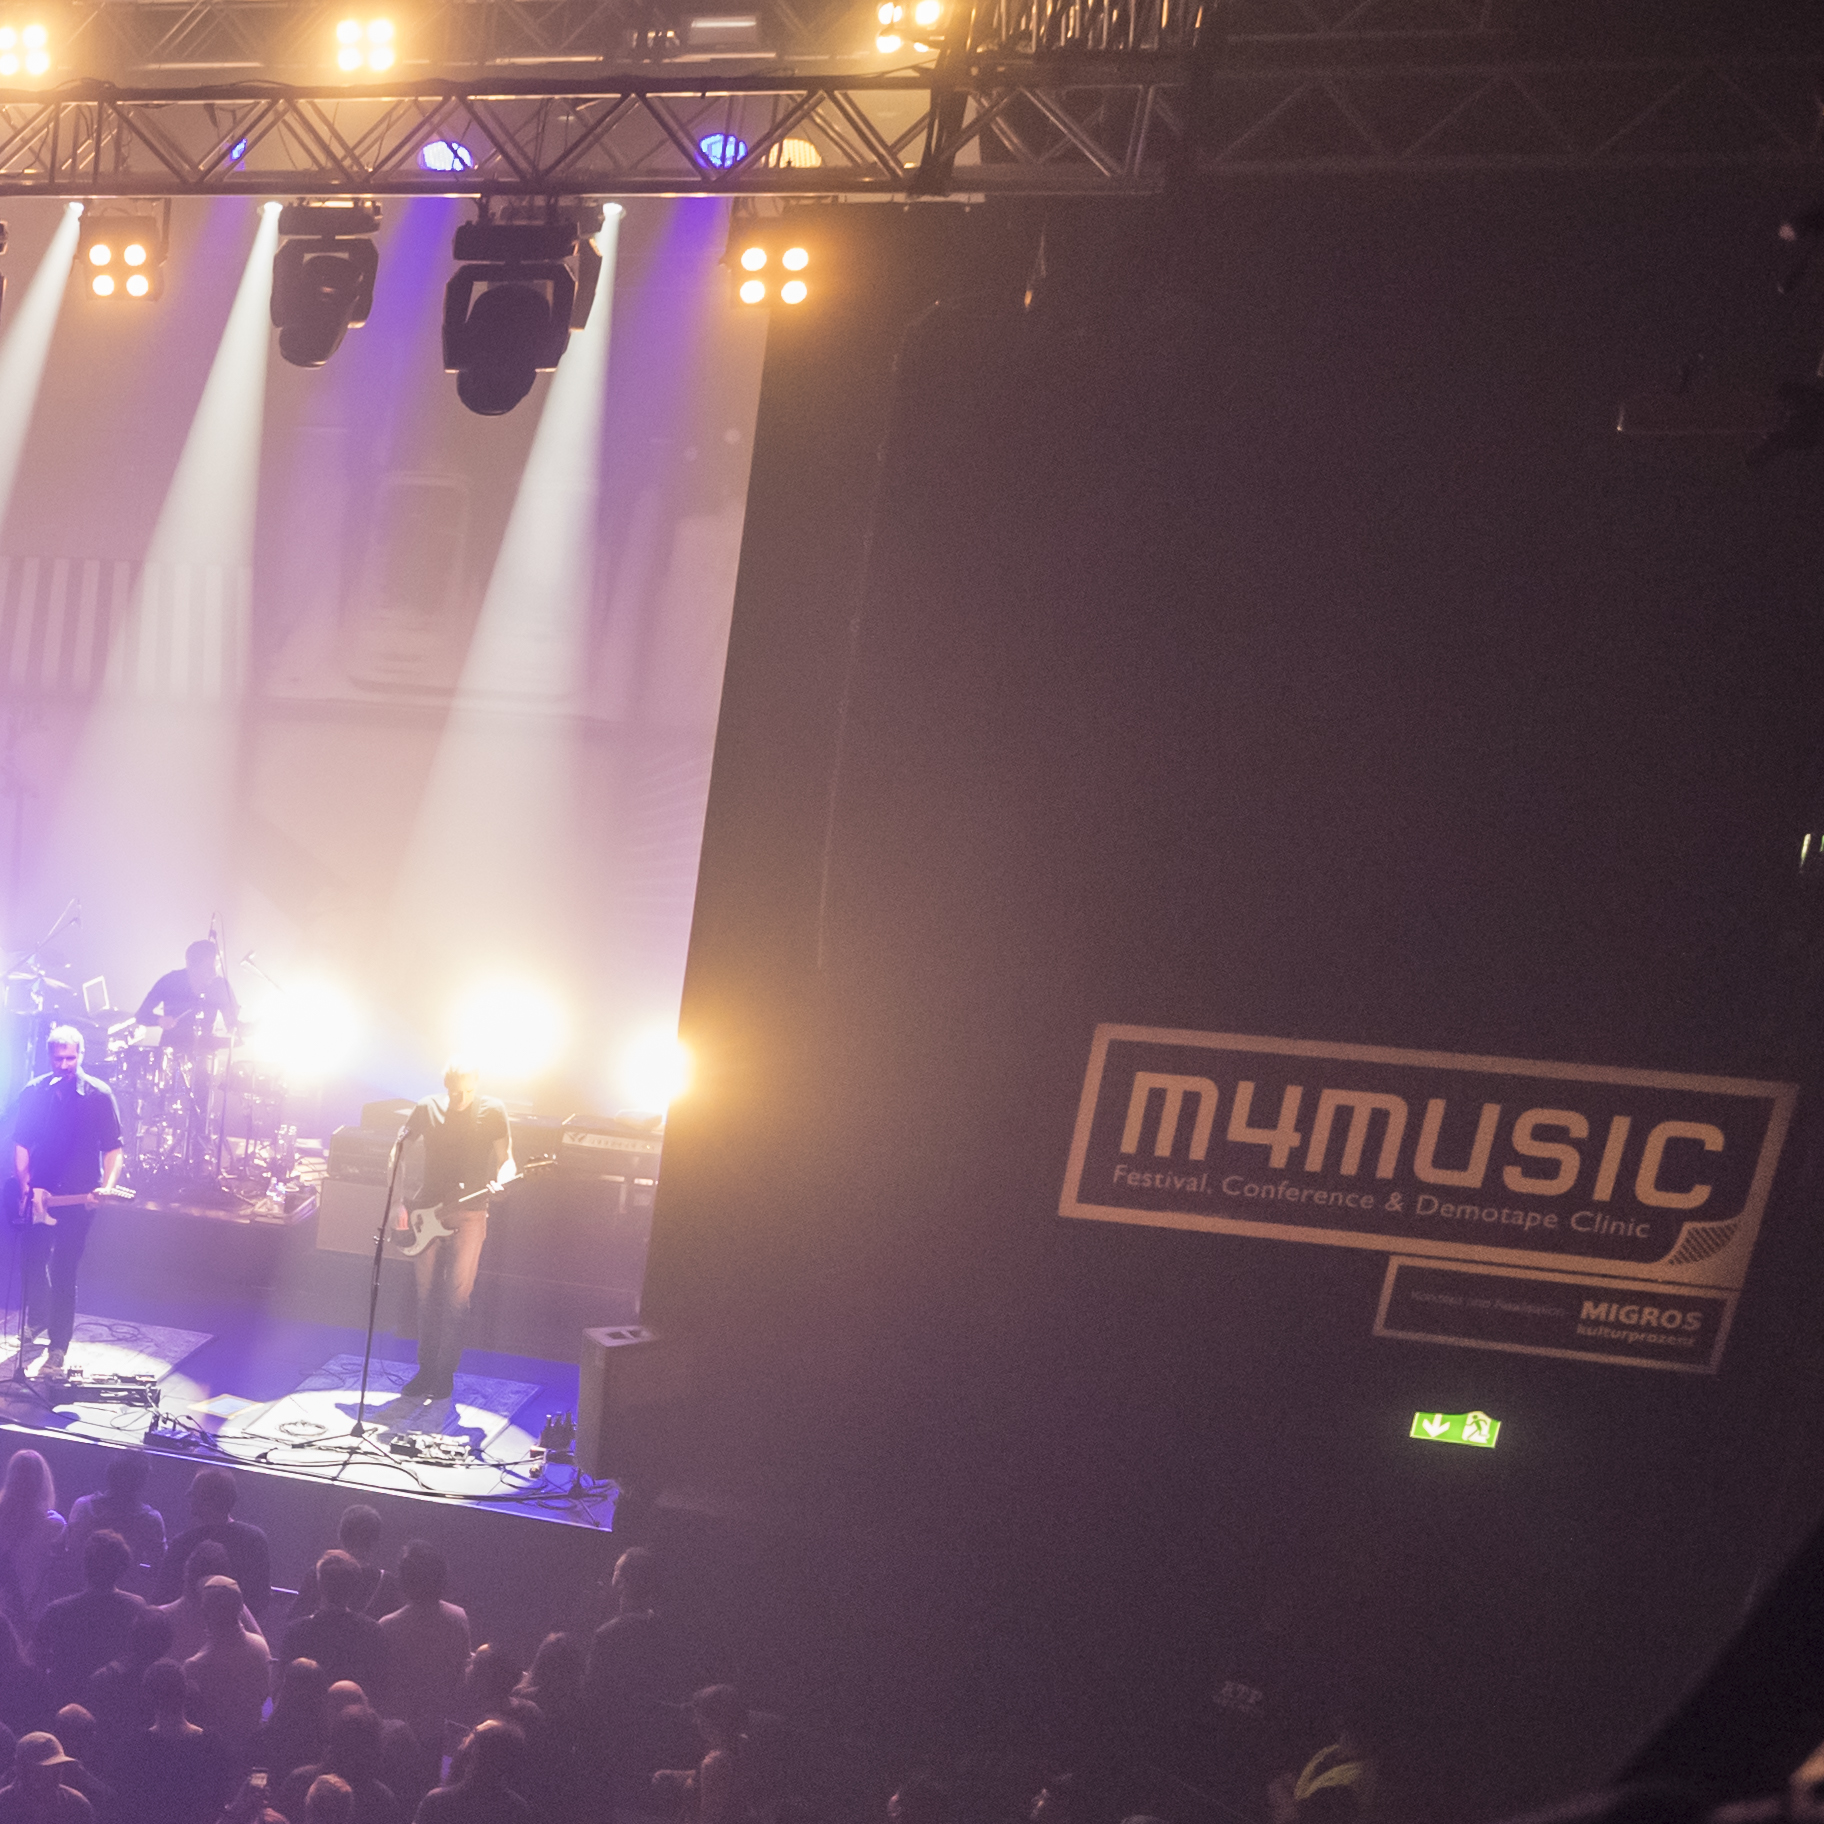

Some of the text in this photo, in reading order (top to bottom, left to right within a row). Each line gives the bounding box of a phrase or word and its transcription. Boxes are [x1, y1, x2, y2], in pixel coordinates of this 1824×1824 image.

[1222, 1174, 1375, 1209] Conference
[1384, 1191, 1405, 1212] &
[1415, 1194, 1558, 1231] Demotape
[1570, 1210, 1651, 1239] Clinic
[1580, 1300, 1703, 1331] MIGROS
